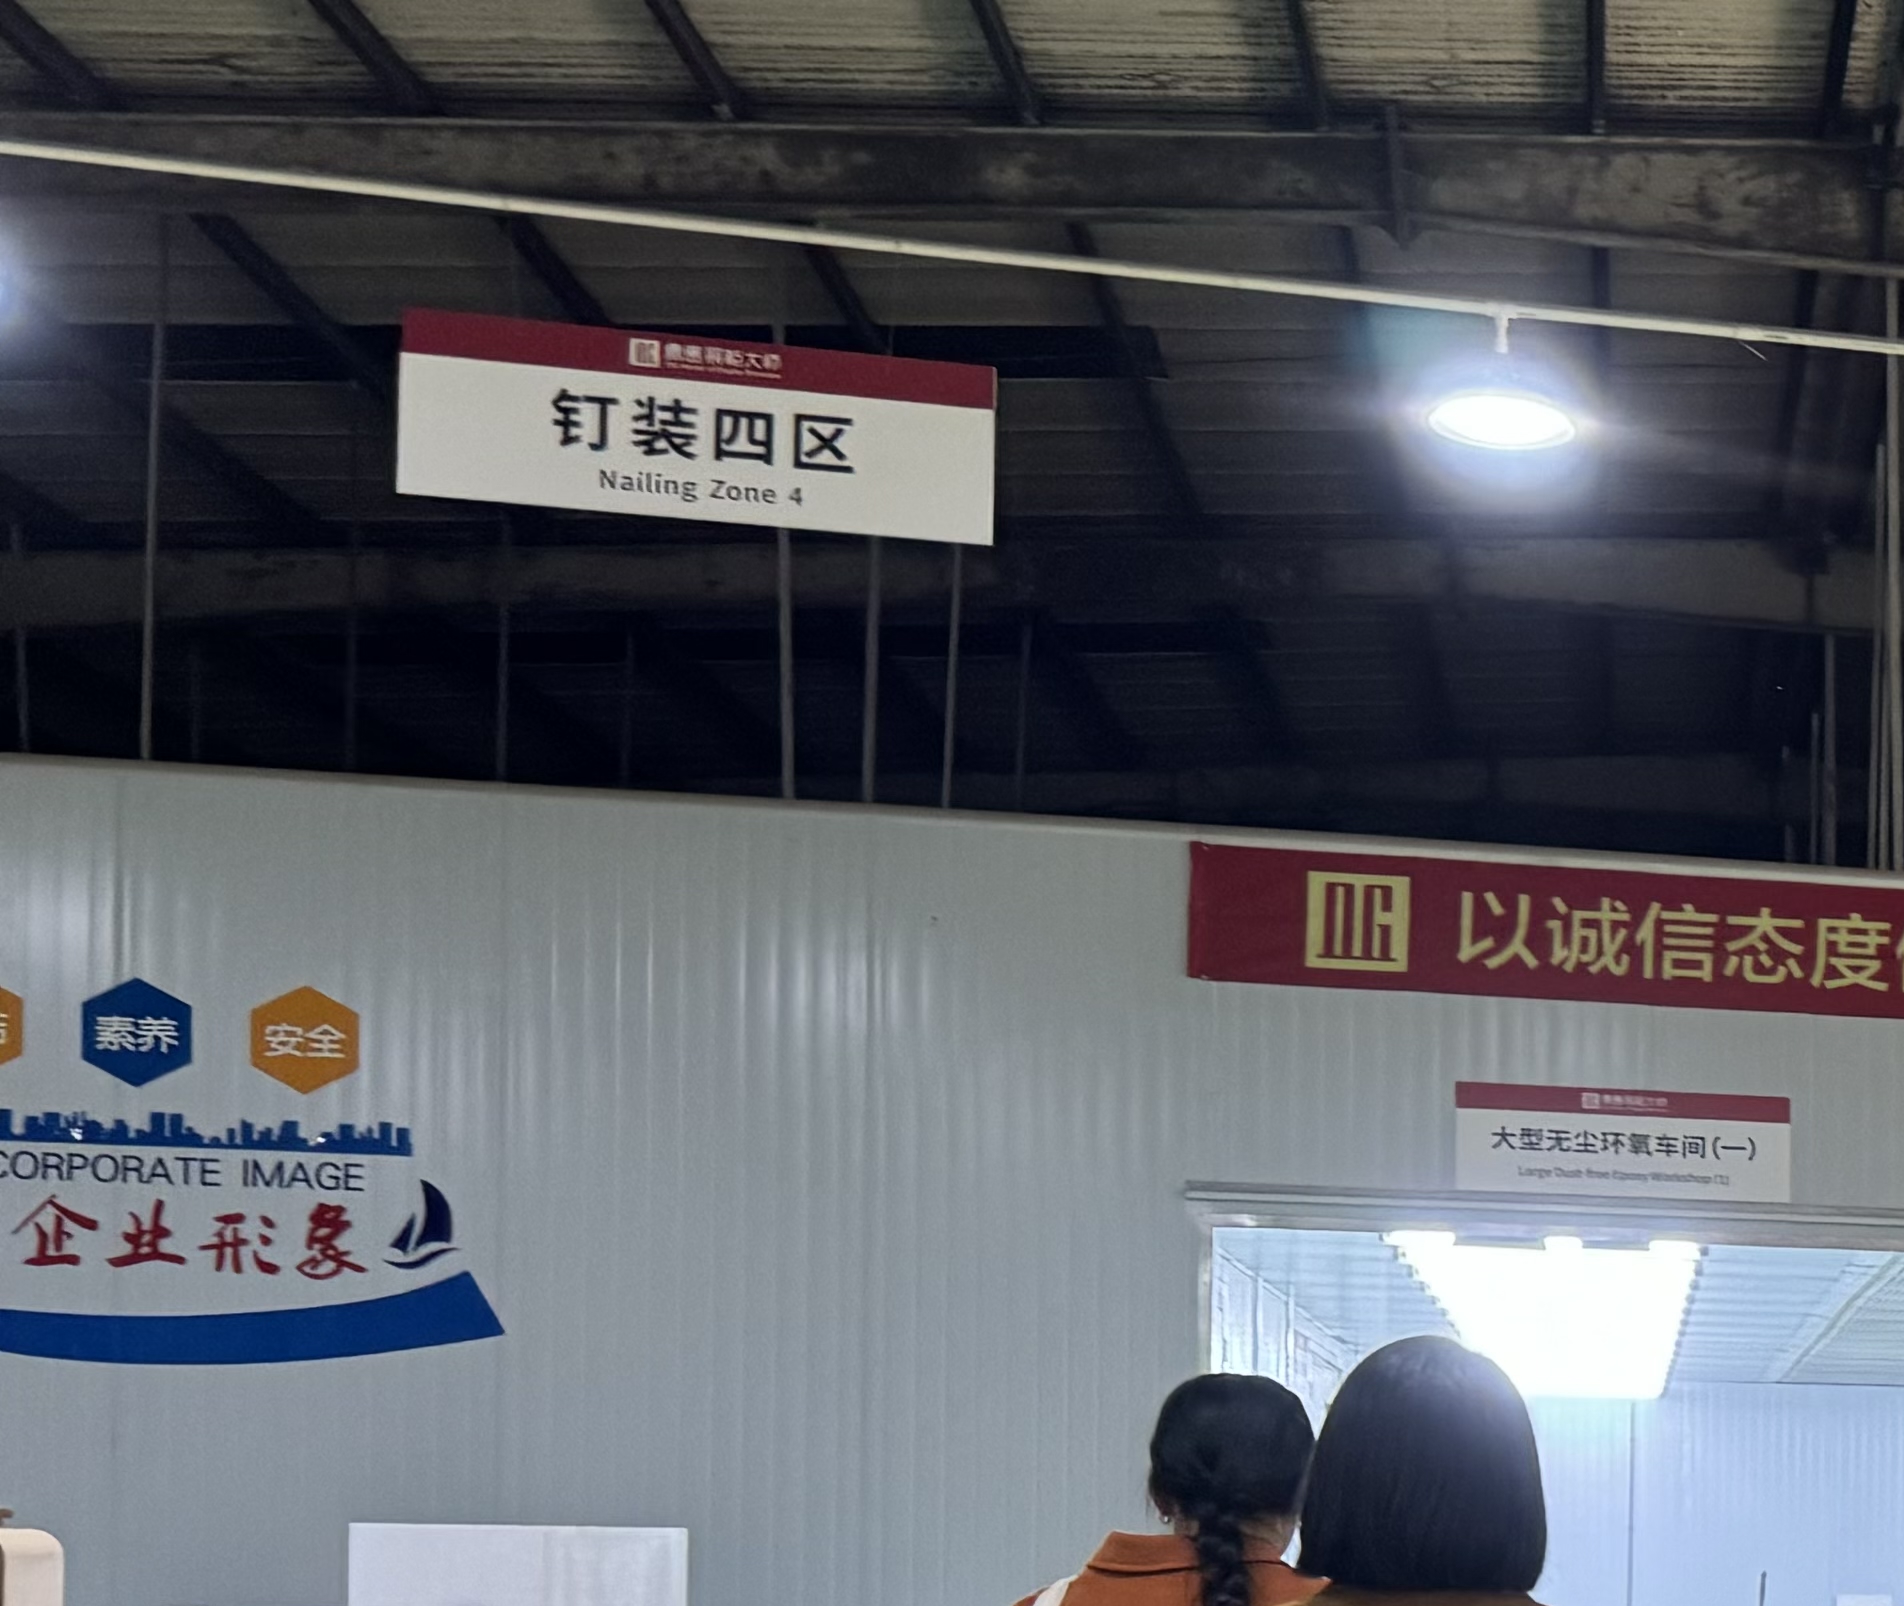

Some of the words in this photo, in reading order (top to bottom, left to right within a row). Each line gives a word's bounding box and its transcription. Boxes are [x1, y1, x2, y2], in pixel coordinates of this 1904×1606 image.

[551, 388, 854, 474] 钉装四区
[599, 468, 699, 502] Nailing
[708, 478, 778, 505] Zone
[787, 487, 803, 506] 4
[94, 1014, 180, 1054] 素养
[262, 1022, 347, 1059] 安全
[242, 1159, 366, 1193] IMAGE
[12, 1194, 369, 1280] 企业形象
